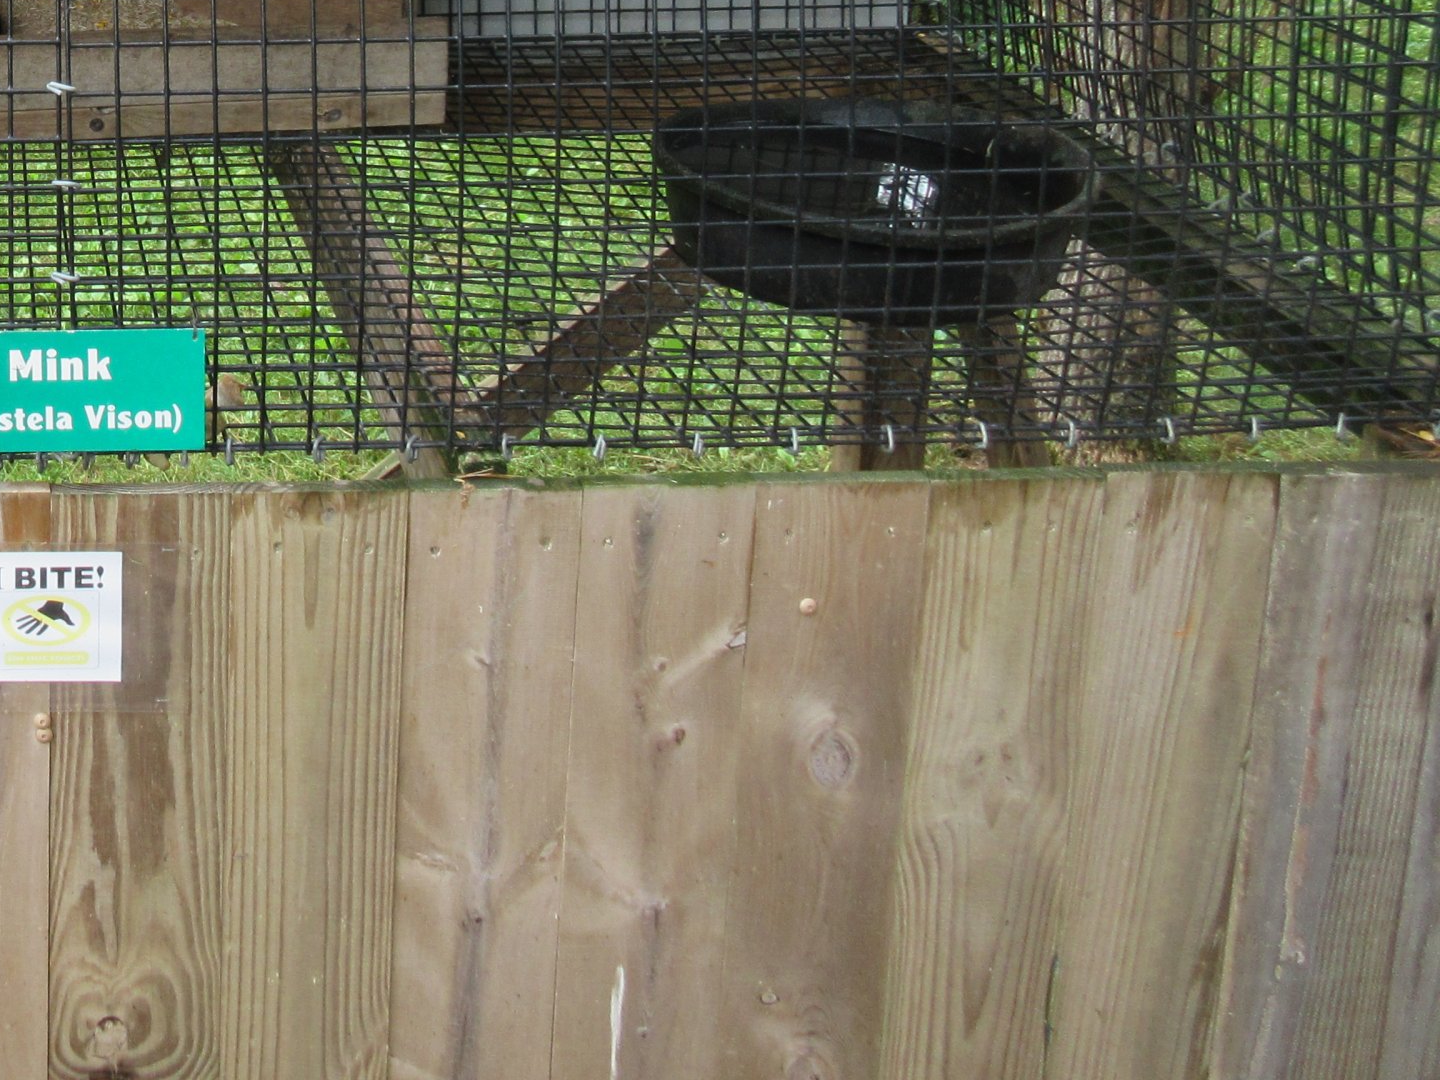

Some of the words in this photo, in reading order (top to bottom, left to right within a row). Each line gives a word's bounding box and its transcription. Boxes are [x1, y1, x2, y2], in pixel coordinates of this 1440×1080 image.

[9, 348, 112, 382] Mink
[84, 403, 182, 434] Vison)
[15, 566, 104, 589] BITE!
